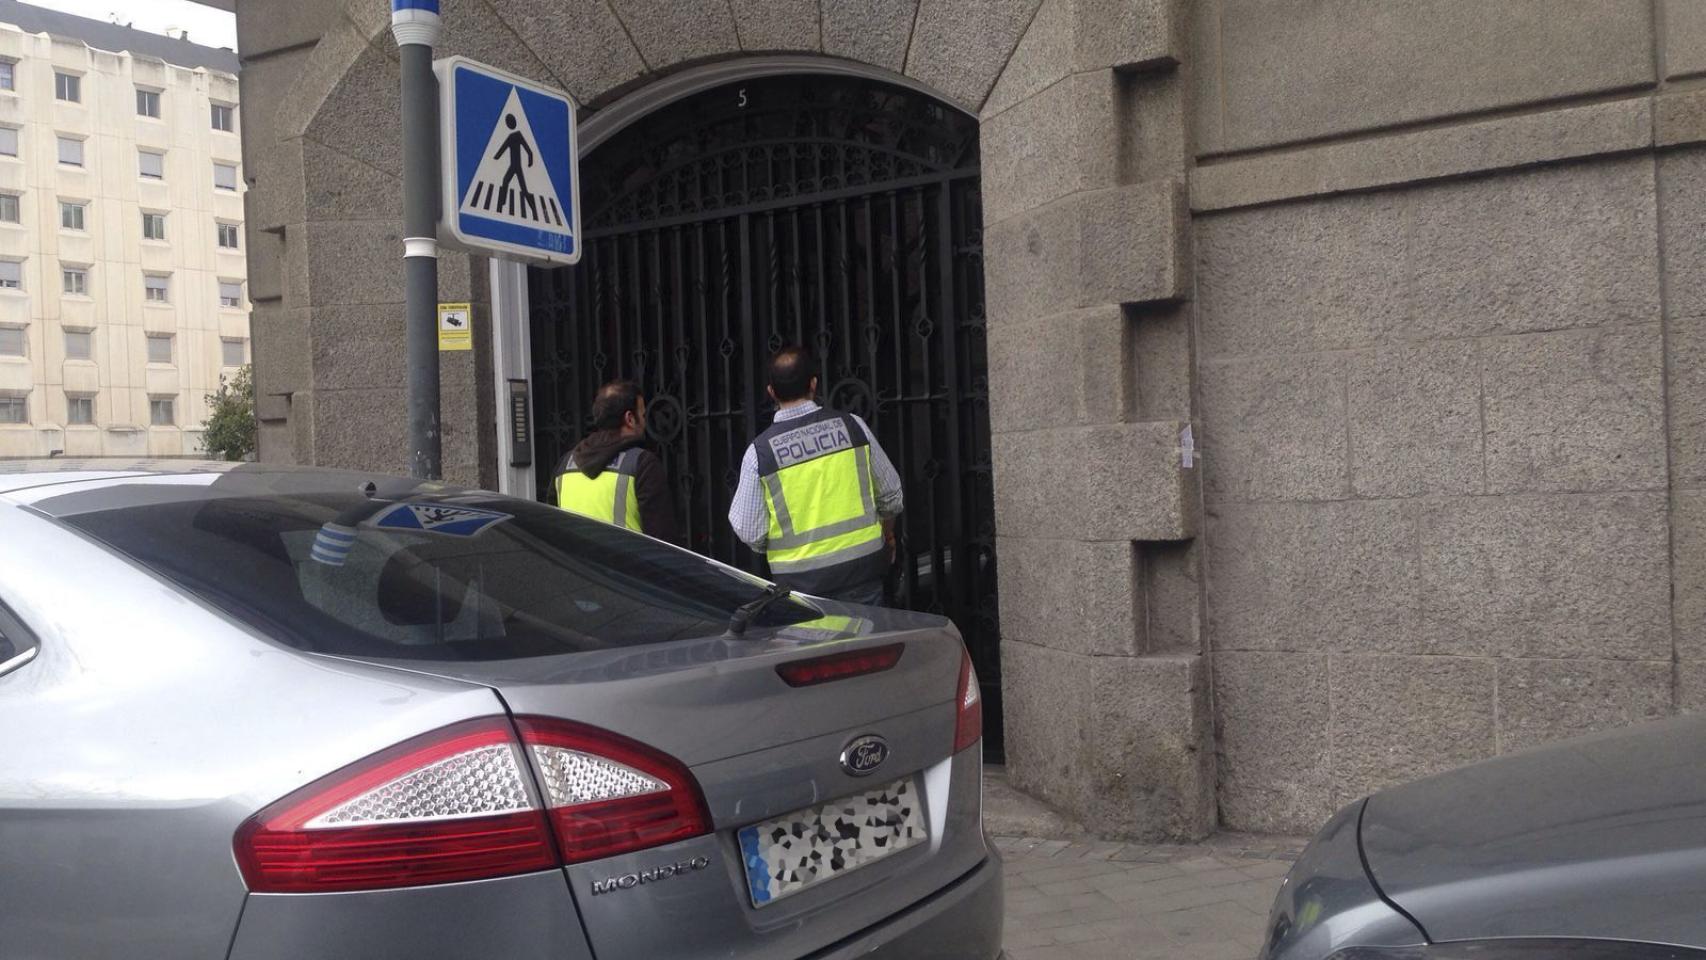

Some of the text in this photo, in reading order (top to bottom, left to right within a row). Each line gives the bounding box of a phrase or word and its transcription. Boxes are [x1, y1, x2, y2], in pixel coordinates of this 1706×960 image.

[738, 88, 747, 107] 5
[772, 419, 842, 447] CUERPO NACIONAL DE
[776, 430, 849, 464] POLICIA
[855, 743, 882, 769] Ford
[591, 856, 710, 896] MONDEO
